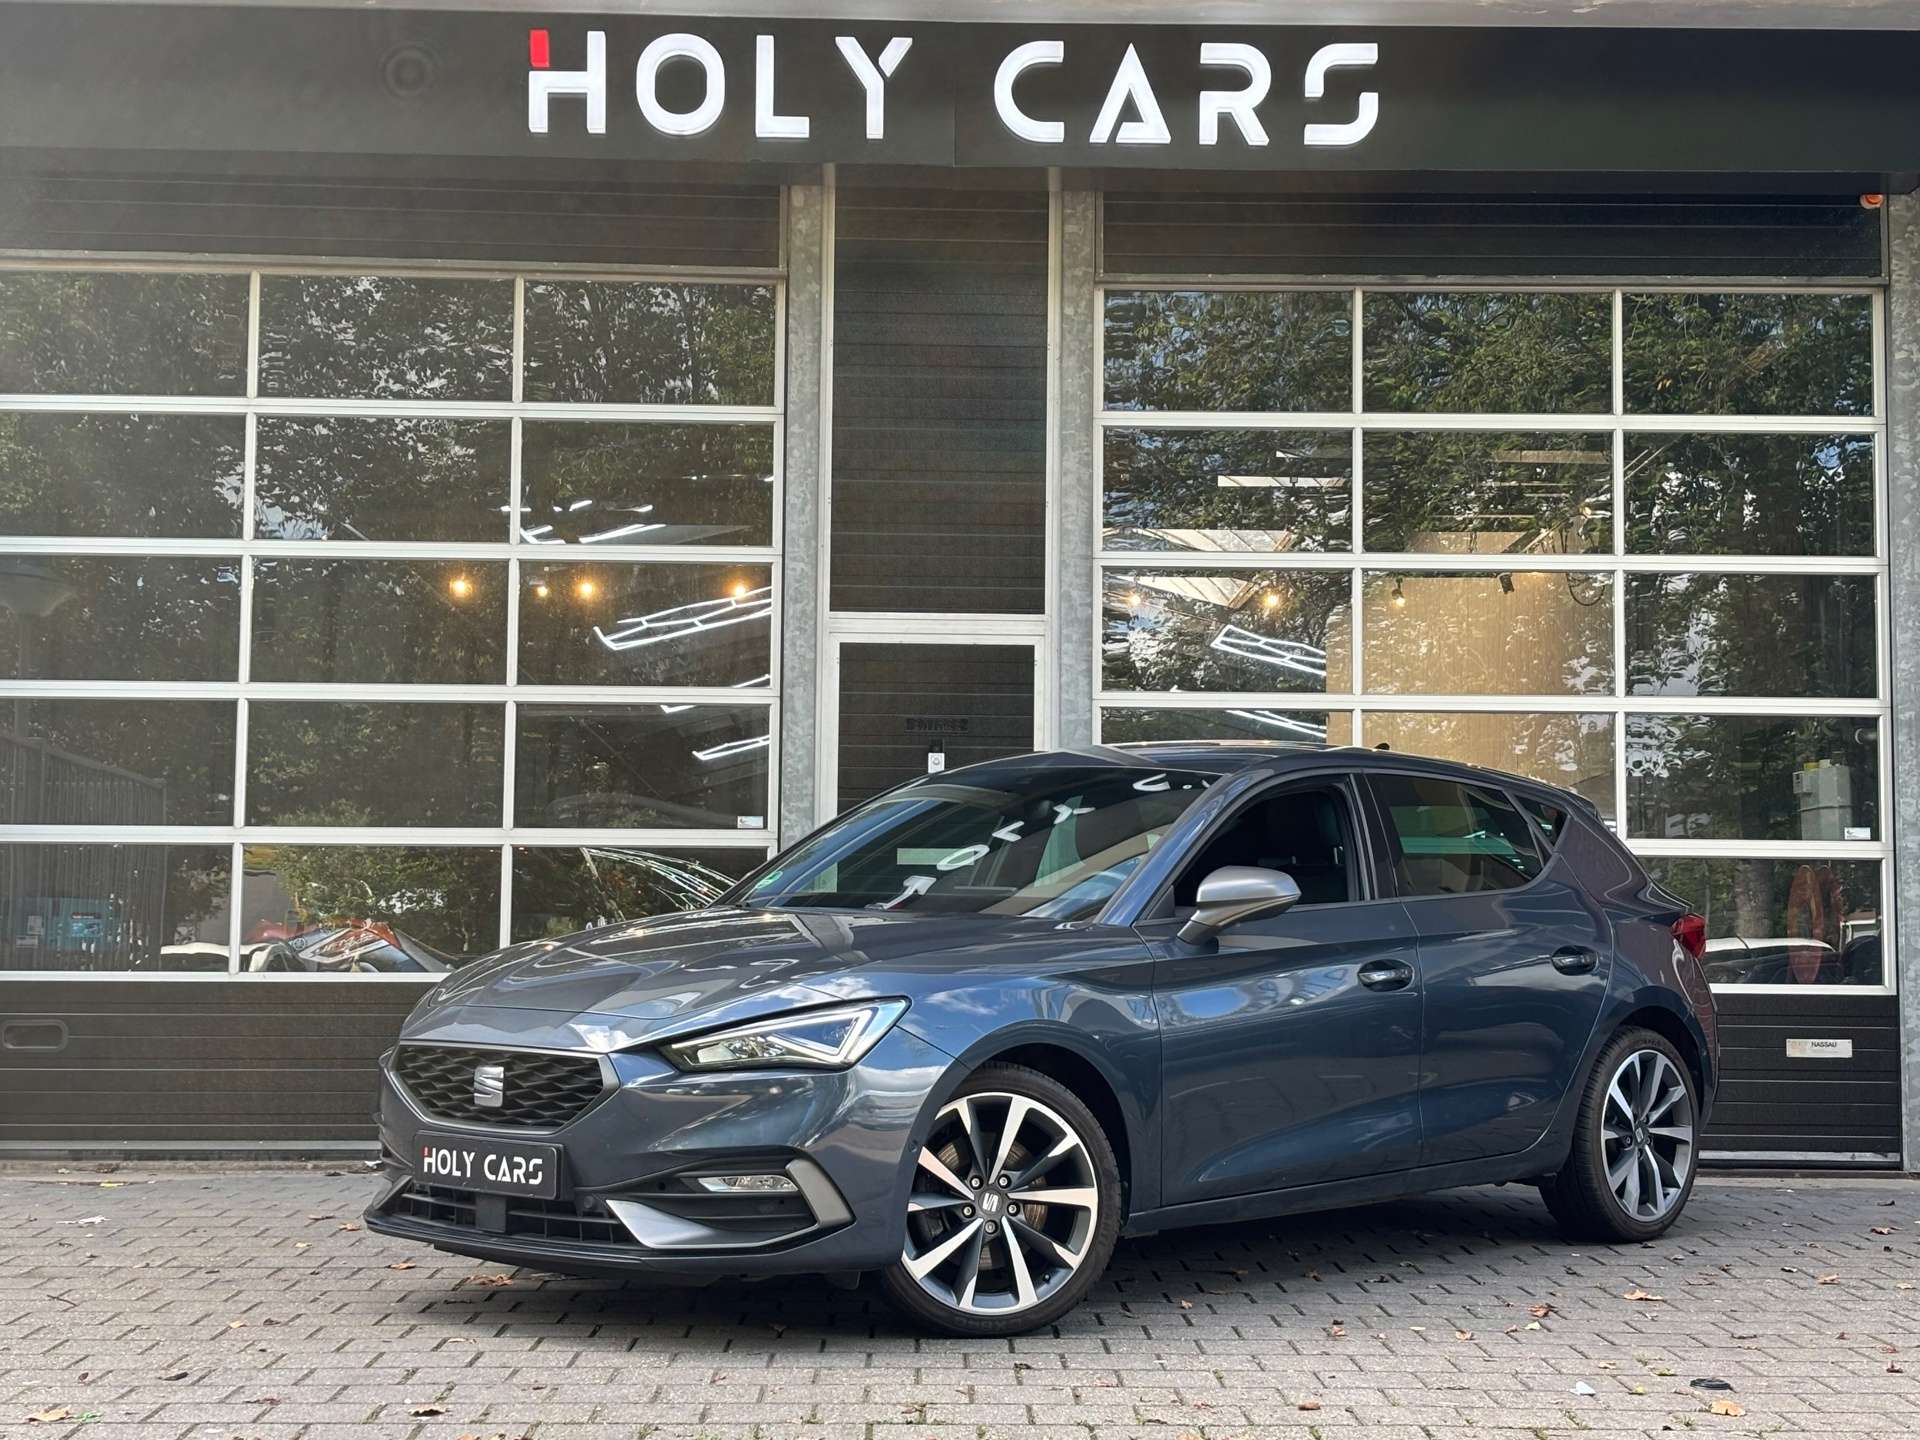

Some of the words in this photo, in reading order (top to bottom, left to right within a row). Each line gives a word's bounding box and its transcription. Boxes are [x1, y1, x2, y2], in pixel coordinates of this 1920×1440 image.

[527, 29, 913, 140] HOLY
[993, 40, 1379, 146] CARS
[422, 1146, 477, 1178] HOLY
[483, 1154, 543, 1185] CARS
